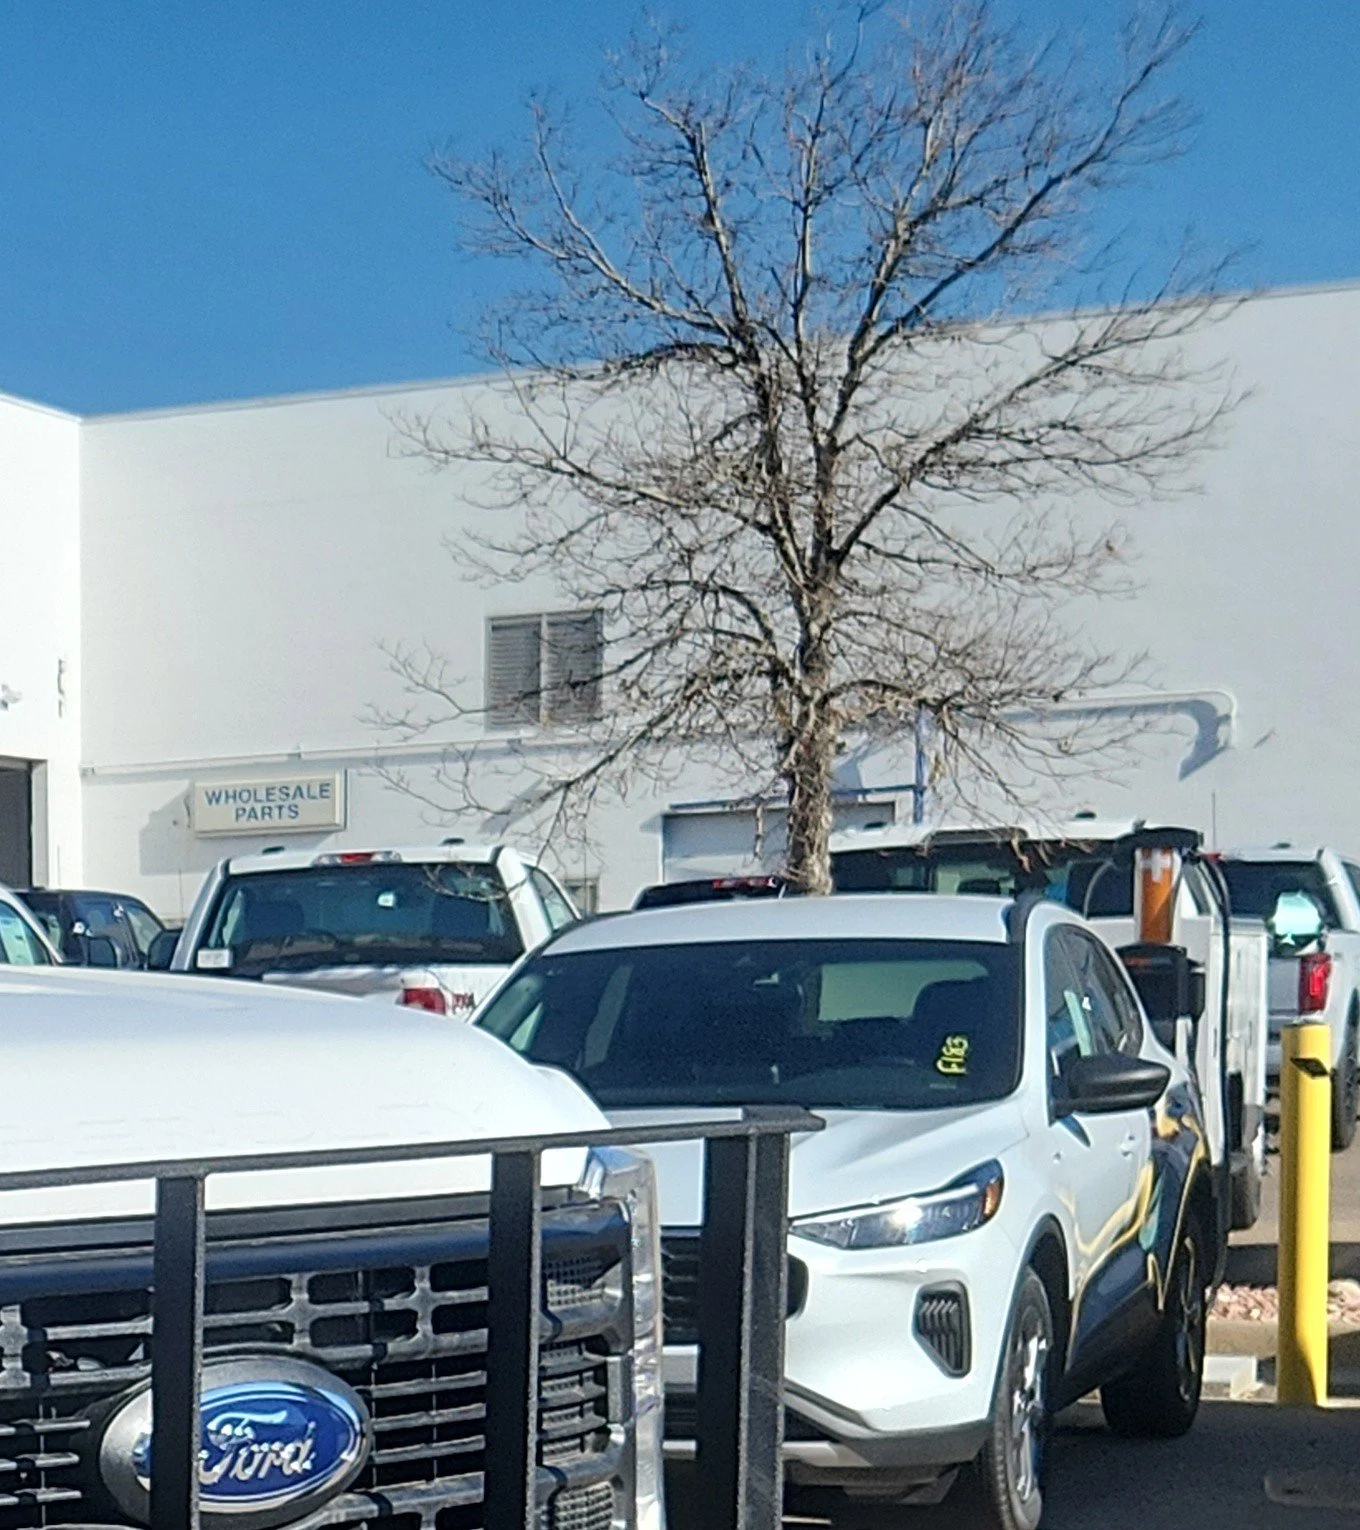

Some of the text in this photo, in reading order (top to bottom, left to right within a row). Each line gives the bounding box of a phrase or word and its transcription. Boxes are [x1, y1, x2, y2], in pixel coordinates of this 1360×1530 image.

[204, 783, 331, 805] WHOLESALE
[235, 804, 300, 822] PARTS
[197, 1409, 317, 1486] Ford
